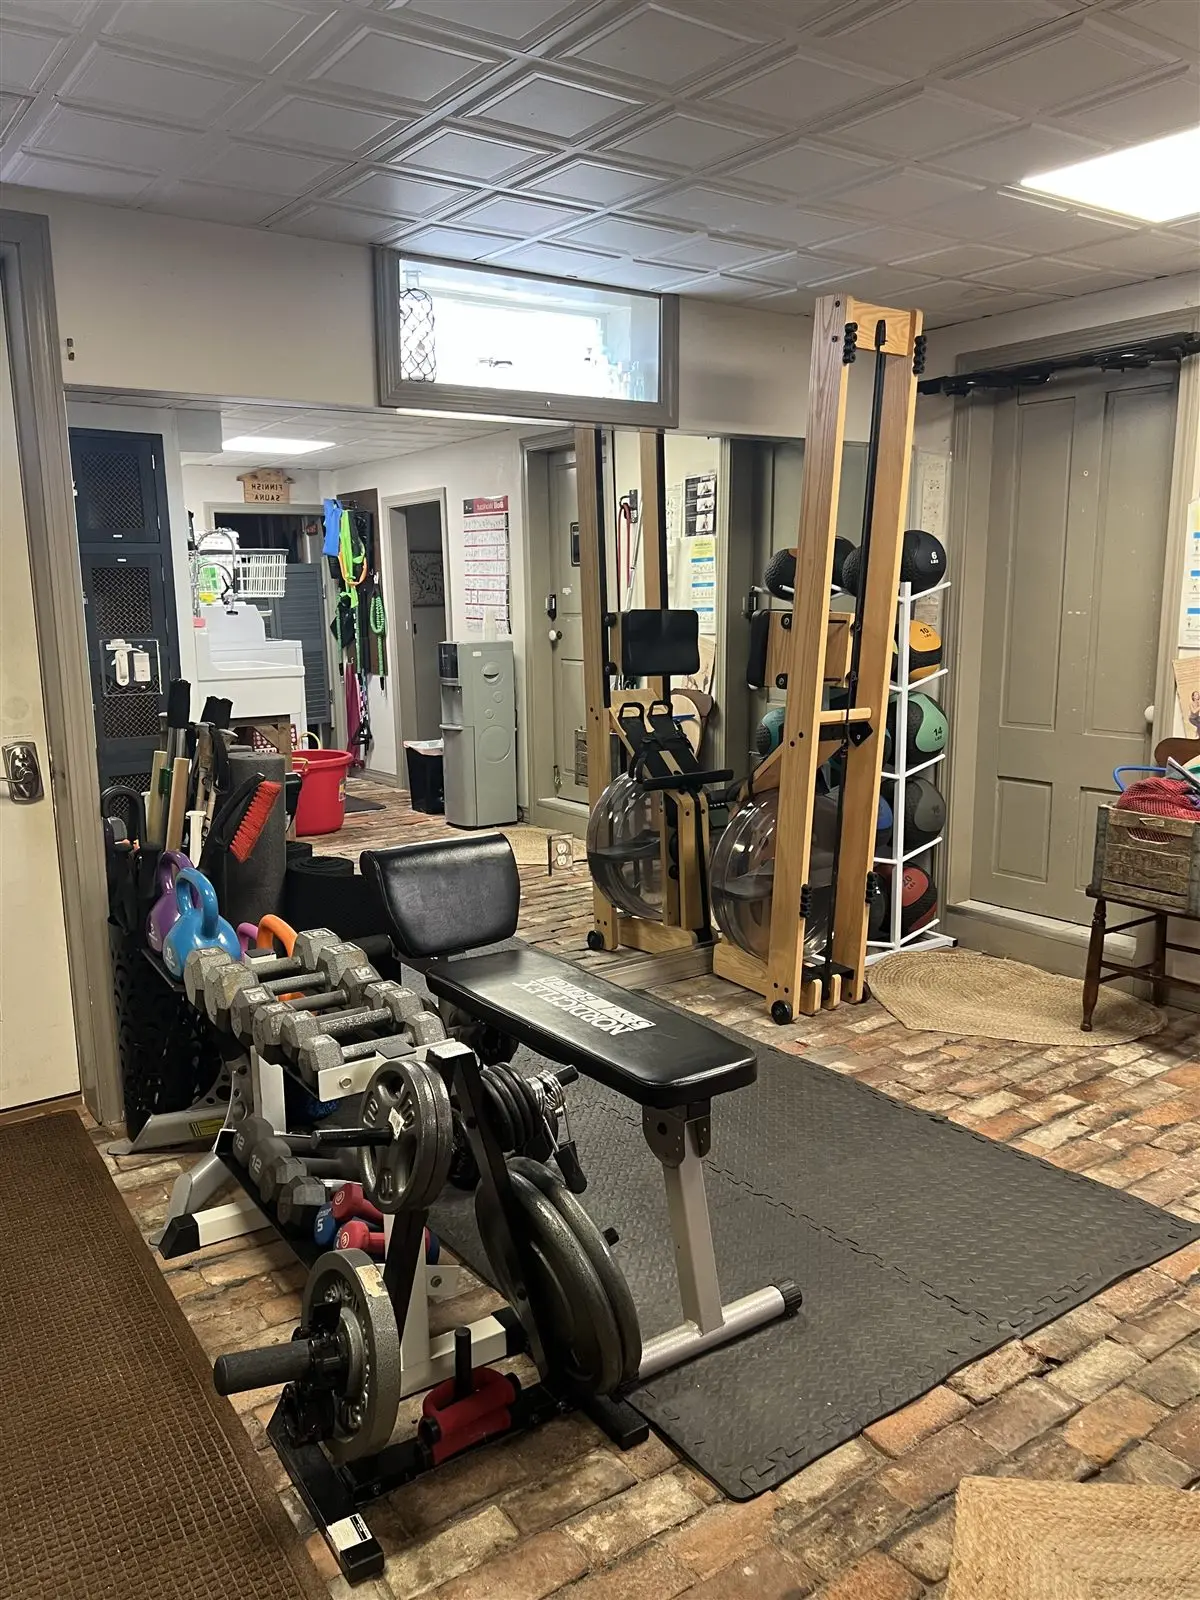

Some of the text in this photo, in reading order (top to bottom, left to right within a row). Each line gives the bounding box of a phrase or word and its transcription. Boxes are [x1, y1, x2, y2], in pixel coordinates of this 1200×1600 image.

[931, 551, 938, 560] 6
[919, 627, 930, 635] 10
[933, 726, 943, 737] 14
[539, 978, 599, 1002] Bench
[512, 980, 634, 1036] NORDICFLEX
[235, 1132, 246, 1150] 12
[251, 1154, 263, 1174] 12
[317, 1217, 324, 1232] 5
